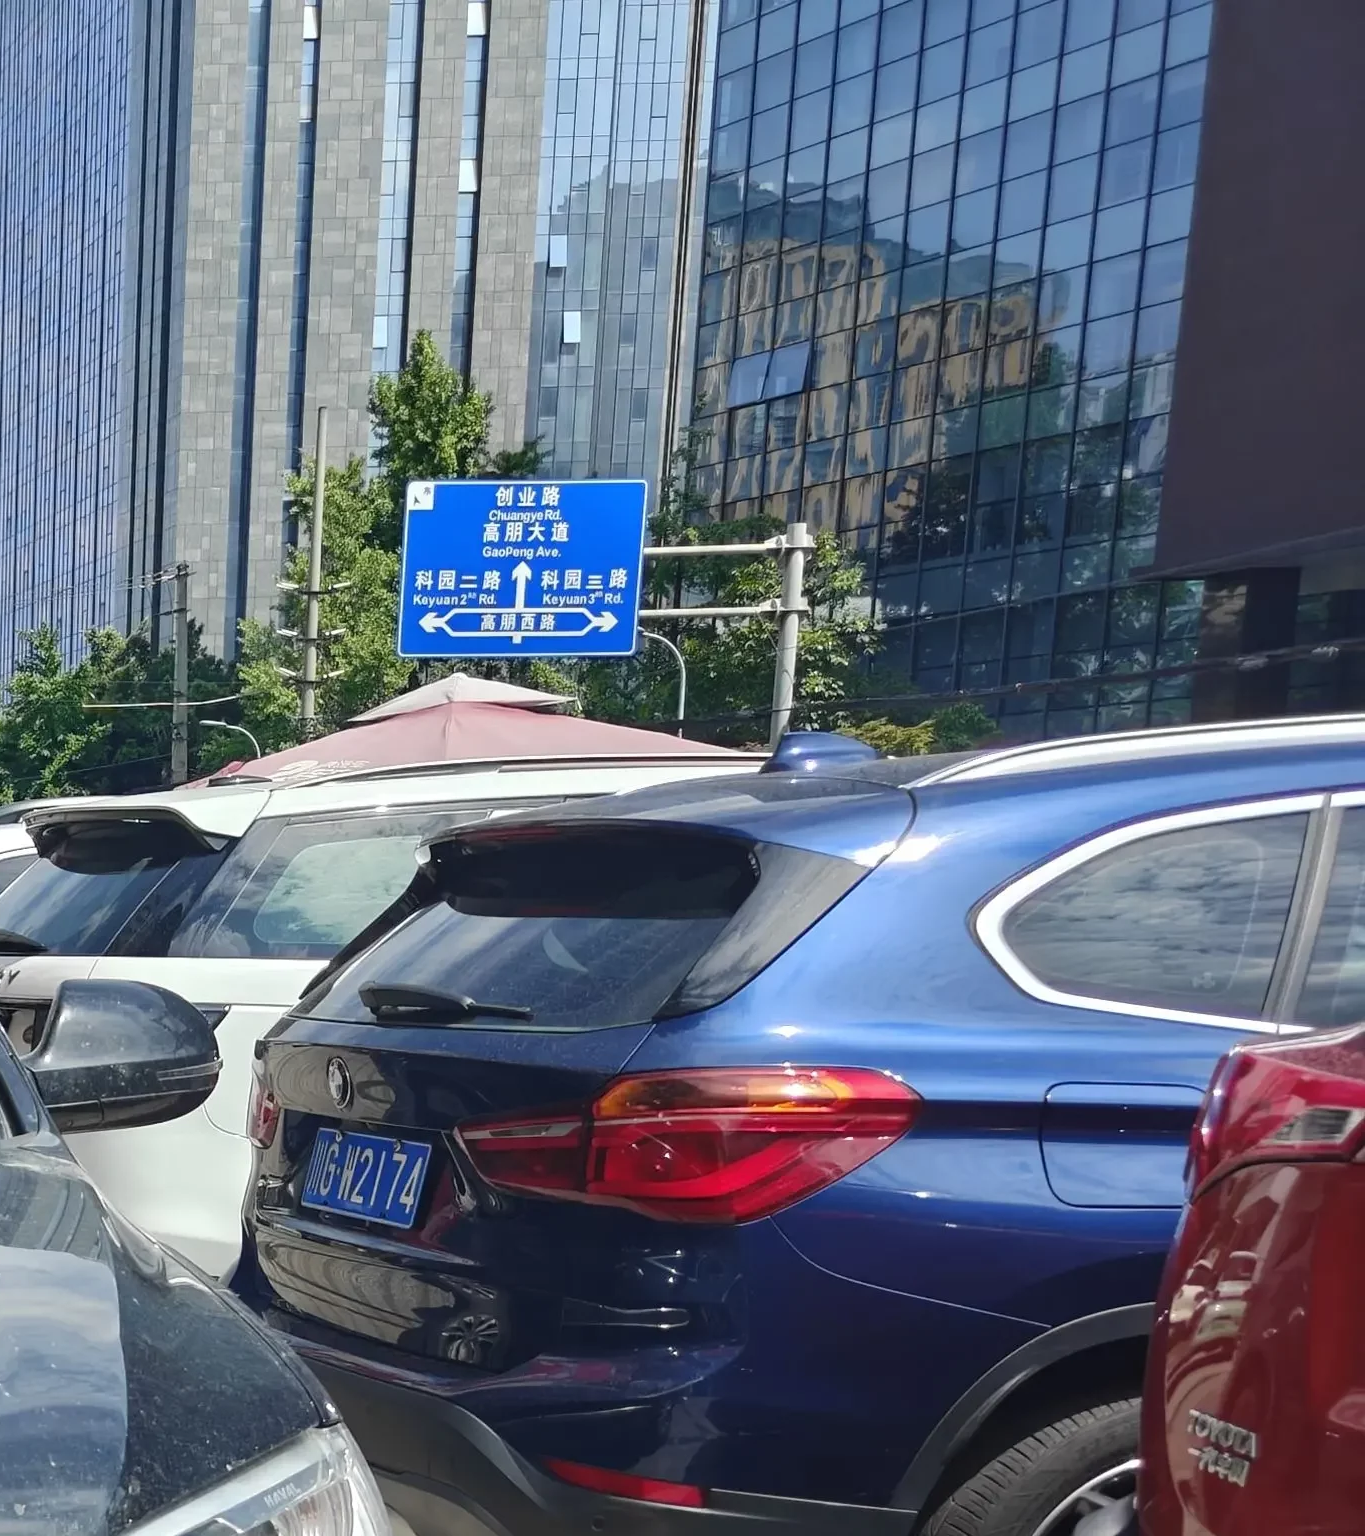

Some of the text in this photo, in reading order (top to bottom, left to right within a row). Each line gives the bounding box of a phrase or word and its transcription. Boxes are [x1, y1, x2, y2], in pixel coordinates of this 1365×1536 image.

[495, 487, 560, 507] 创业路
[489, 510, 563, 523] Chuangye Rd.
[483, 522, 569, 543] 高朋大道
[536, 547, 562, 558] Ave.
[414, 569, 501, 590] 科园二路
[541, 567, 628, 591] 科园三路
[413, 594, 459, 608] Keyuan
[479, 594, 497, 605] Rd.
[542, 593, 587, 607] Keyuan
[604, 592, 624, 605] Rd.
[480, 613, 556, 632] 高朋西路
[1187, 1408, 1256, 1458] TOYOTA
[263, 1482, 303, 1509] HAVAL
